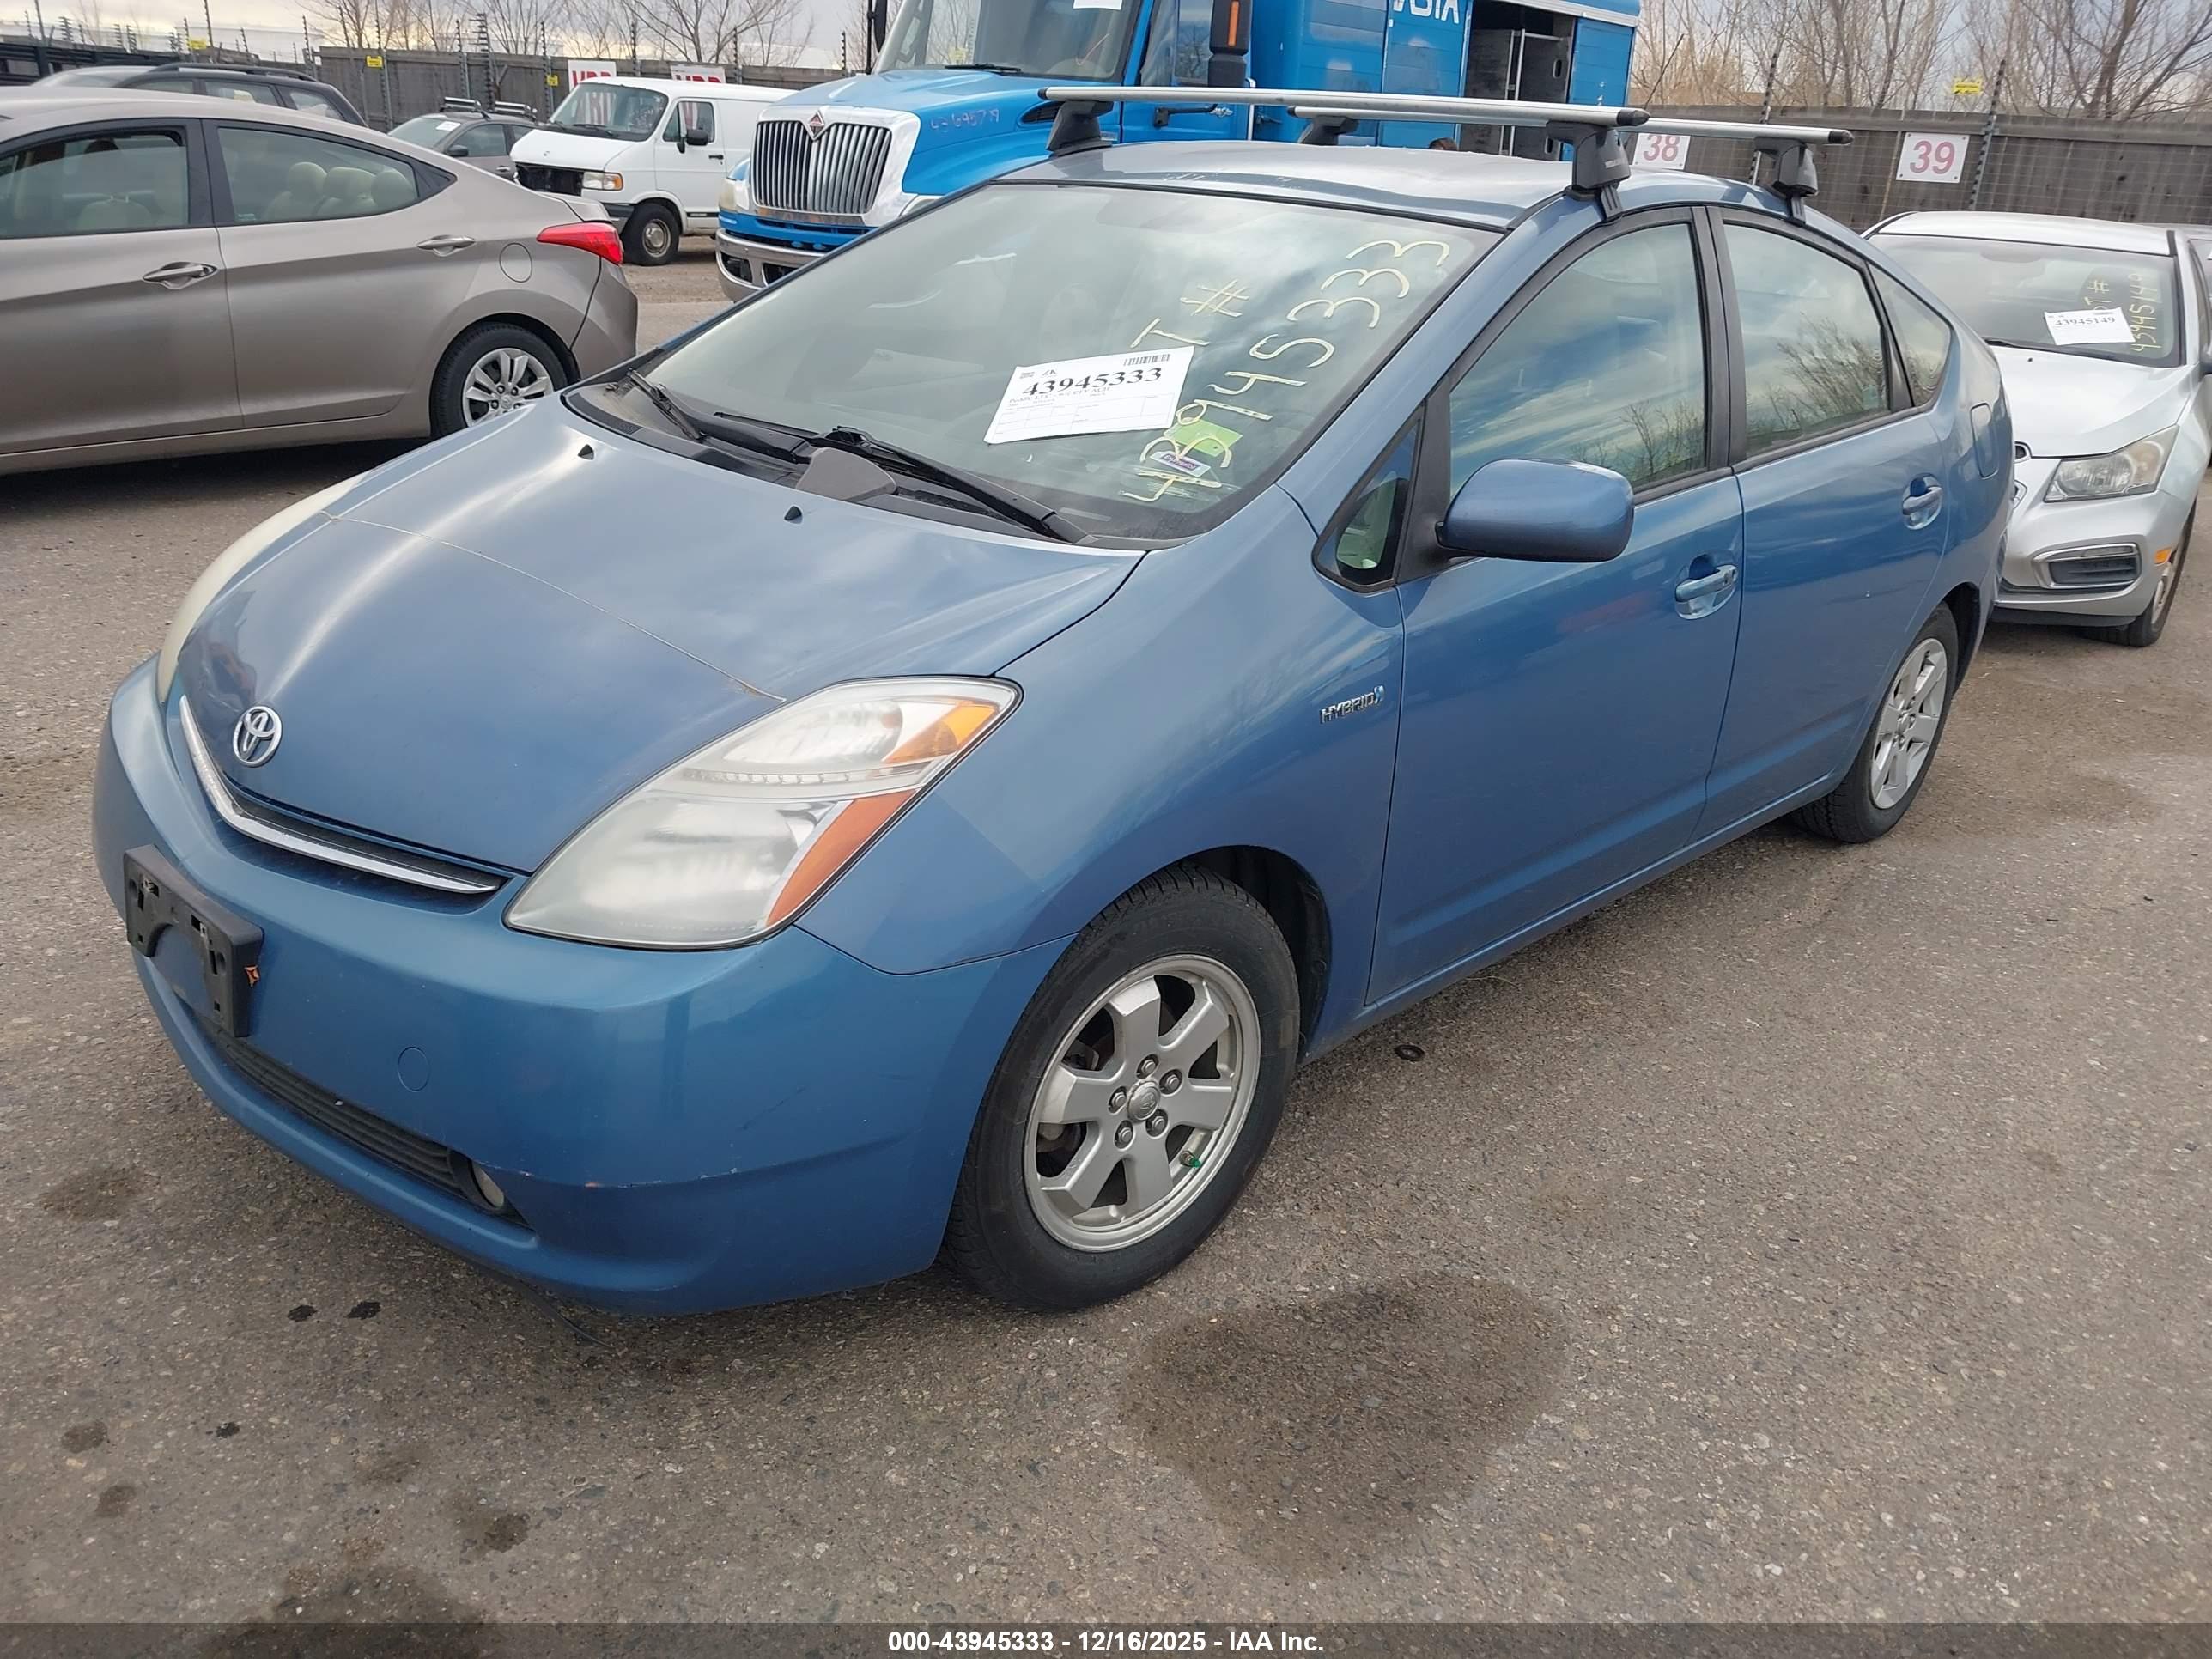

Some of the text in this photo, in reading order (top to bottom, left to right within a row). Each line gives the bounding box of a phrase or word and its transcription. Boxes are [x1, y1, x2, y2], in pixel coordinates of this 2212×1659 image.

[1643, 134, 1680, 161] 38
[1909, 140, 1956, 175] 39
[2055, 316, 2116, 327] 43945149
[1023, 368, 1162, 395] 43945333
[1120, 240, 1450, 502] 43945333
[1320, 692, 1375, 723] HYBRID
